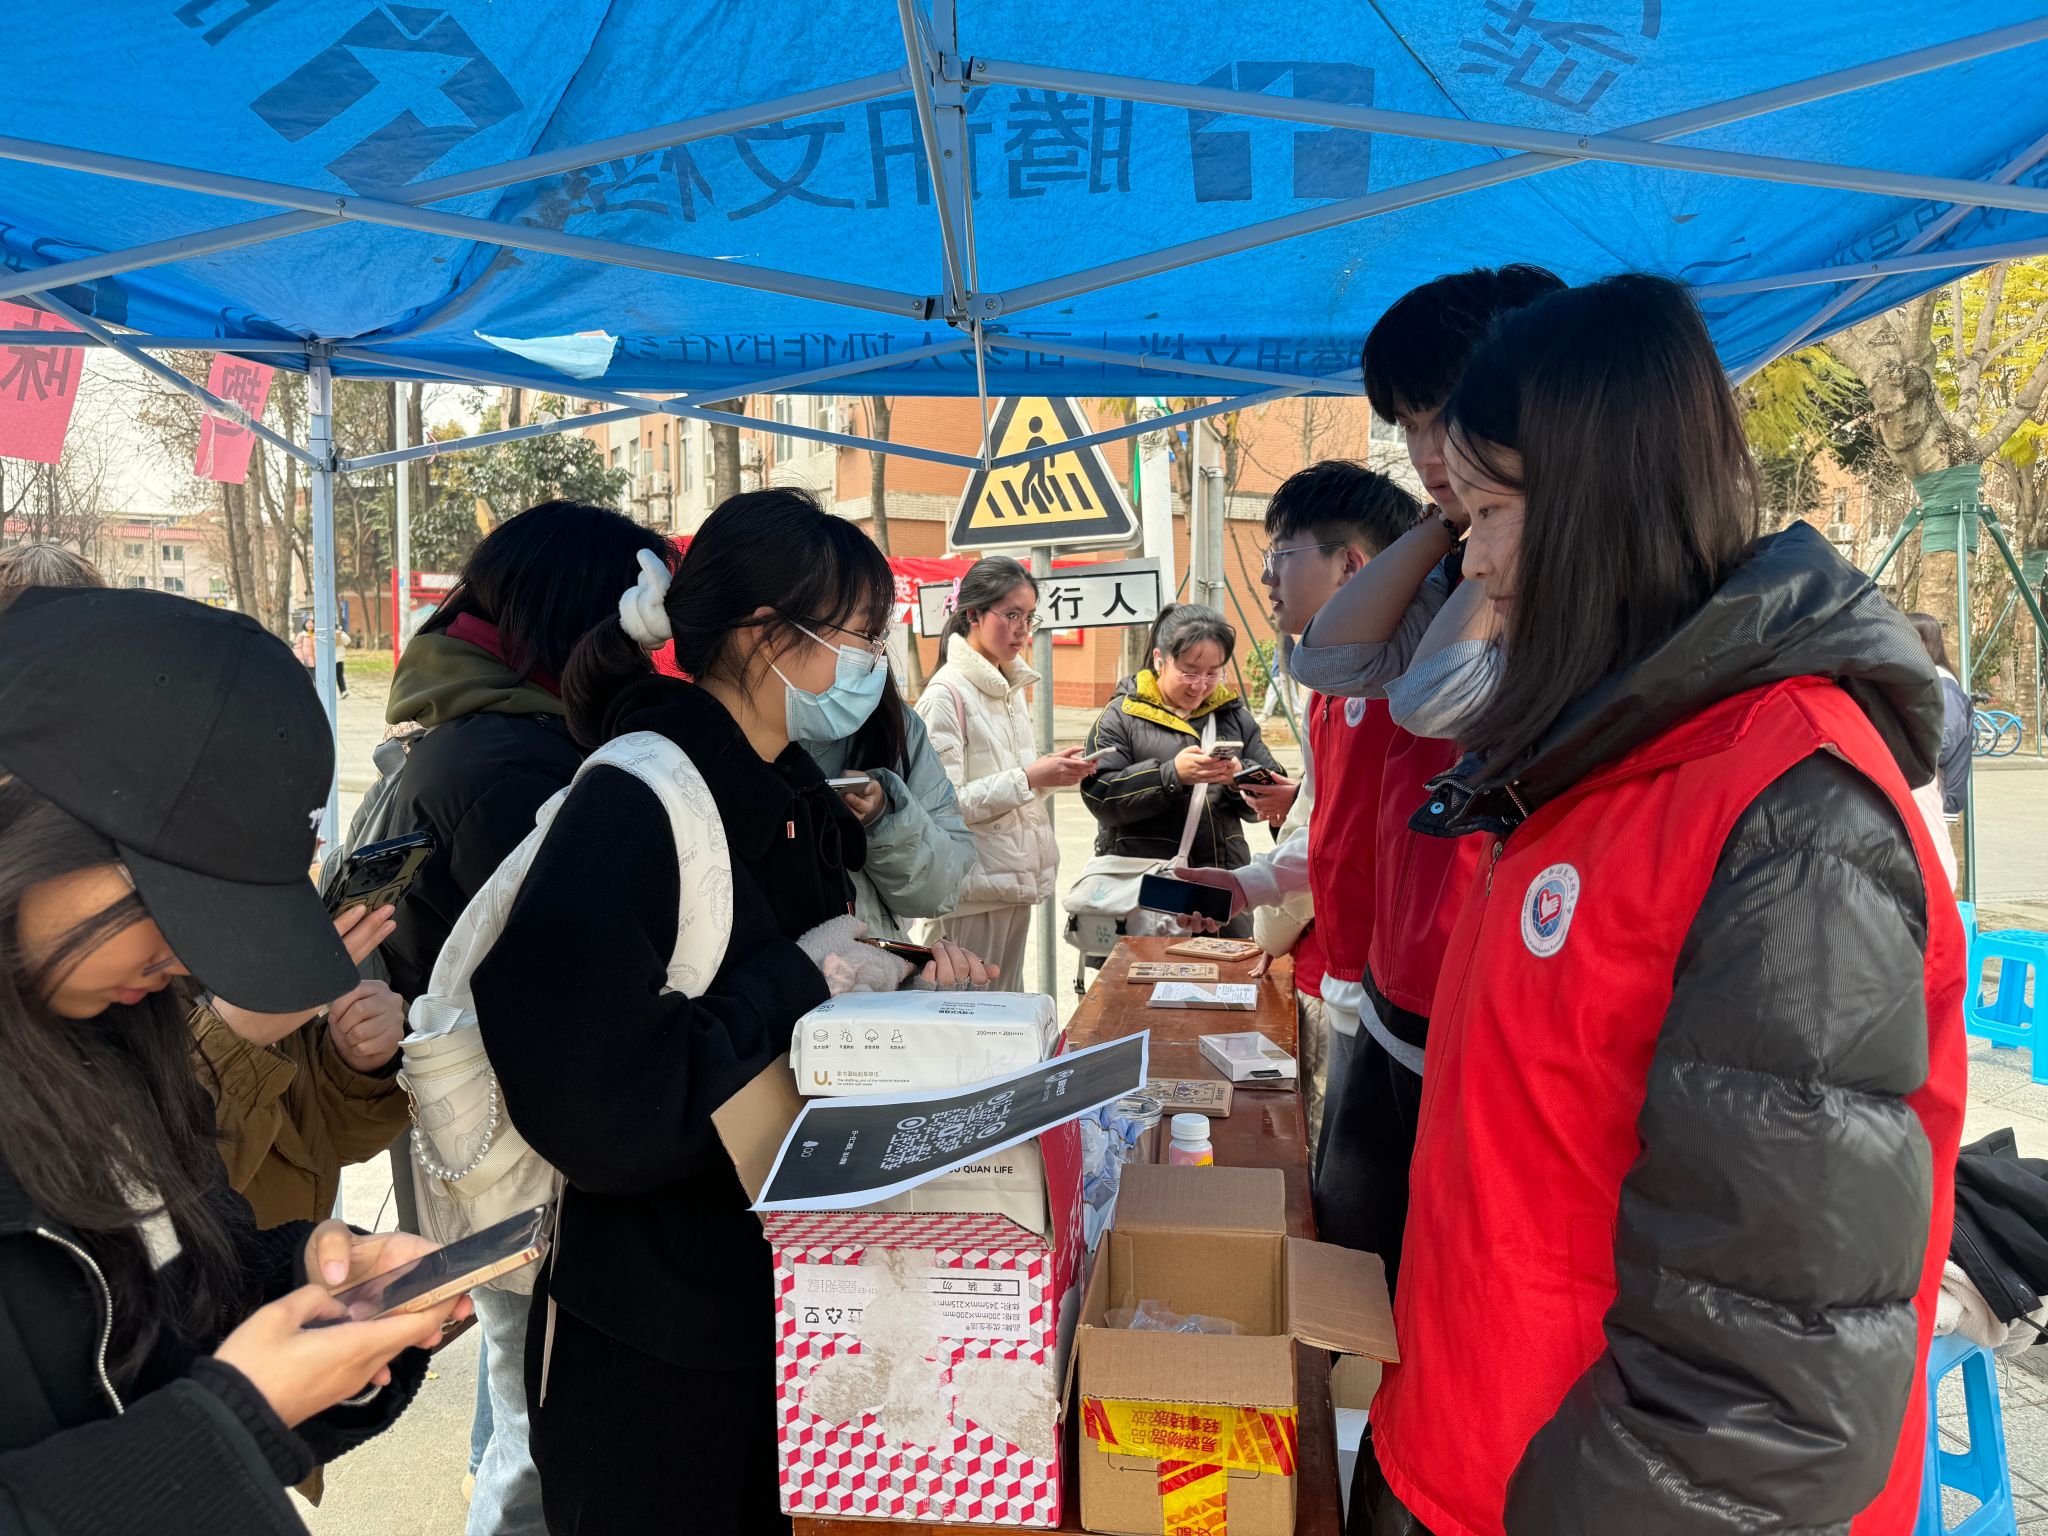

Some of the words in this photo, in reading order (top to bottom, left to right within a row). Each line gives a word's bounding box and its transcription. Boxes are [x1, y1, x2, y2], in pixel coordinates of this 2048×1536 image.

[1048, 582, 1137, 621] 行人
[963, 1165, 991, 1174] QUAN
[994, 1166, 1014, 1174] LIFE
[943, 1281, 1003, 1292] 套装勿
